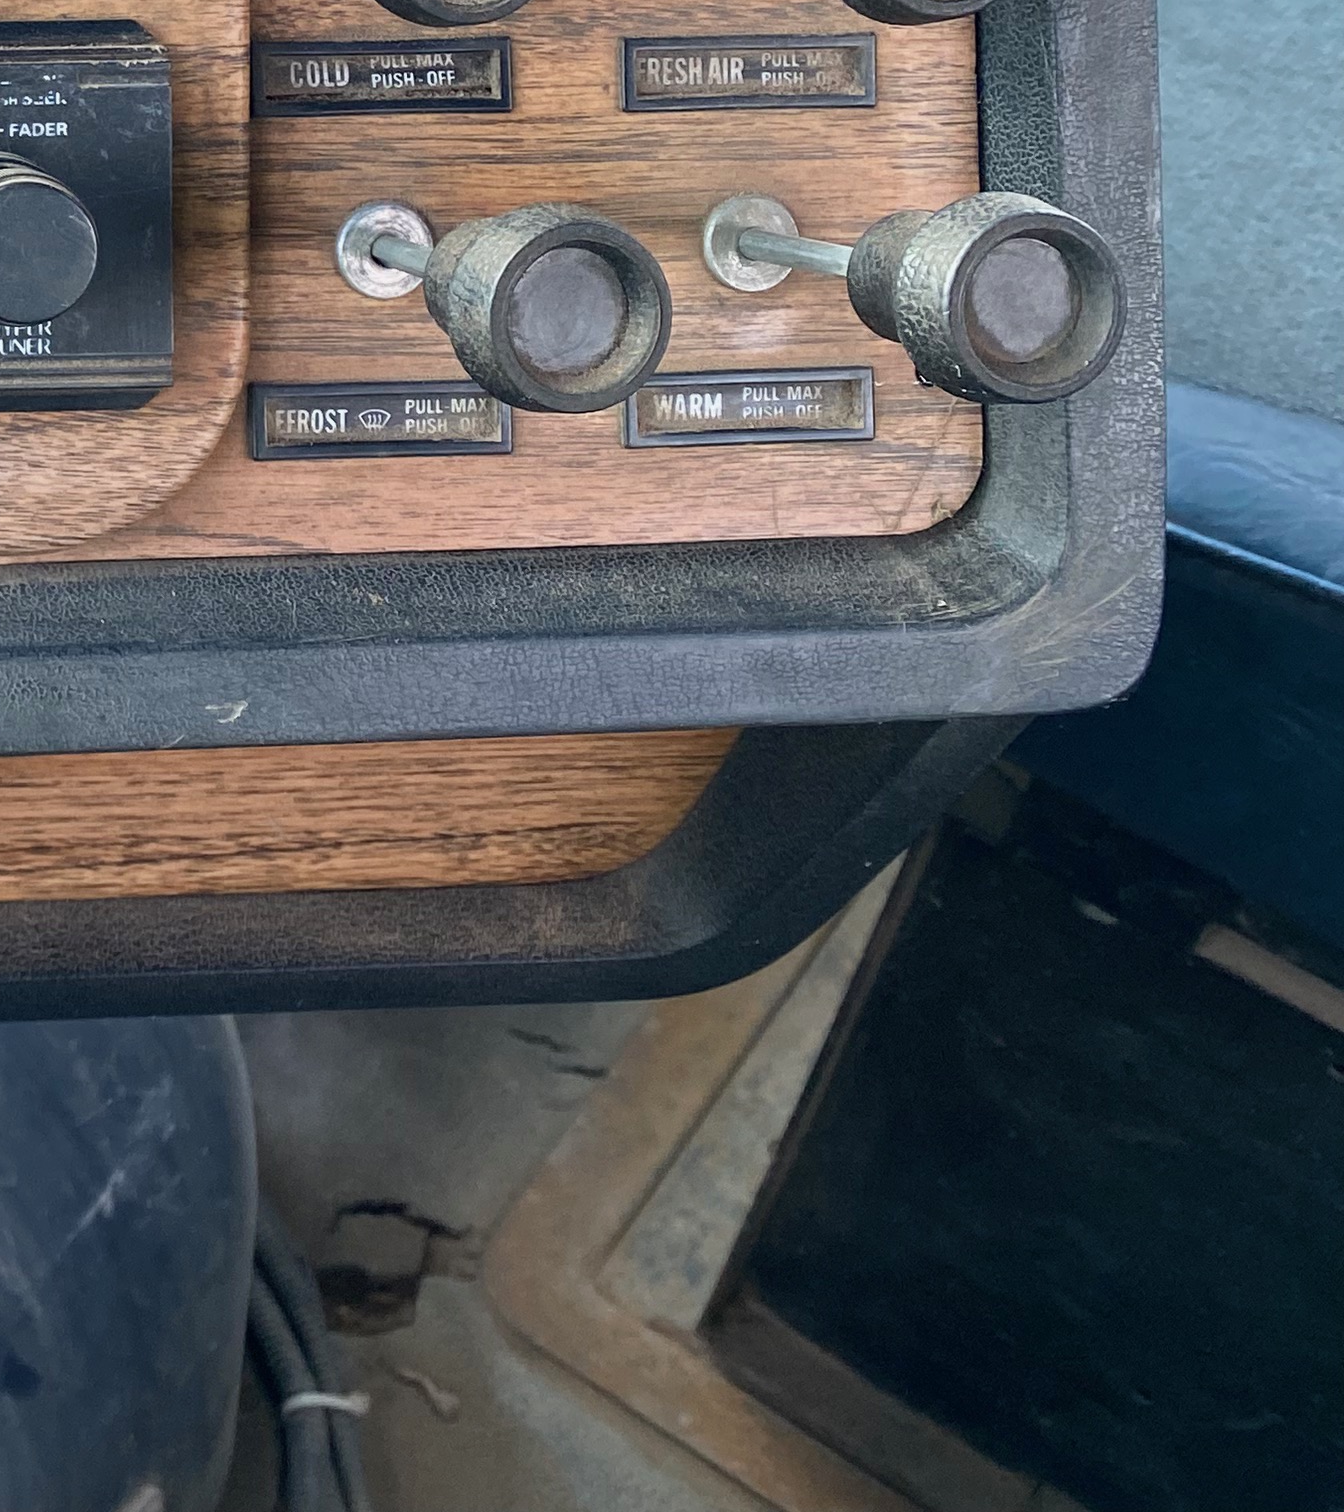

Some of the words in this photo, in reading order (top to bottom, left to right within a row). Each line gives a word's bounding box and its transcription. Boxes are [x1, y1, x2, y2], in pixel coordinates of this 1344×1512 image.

[289, 60, 350, 88] COLD
[639, 57, 703, 87] FRESH
[707, 56, 745, 85] AIR
[762, 71, 804, 87] PUSH
[9, 123, 68, 137] FADER
[653, 393, 723, 420] WARM
[274, 408, 348, 434] EFROST
[405, 419, 447, 435] PUSH
